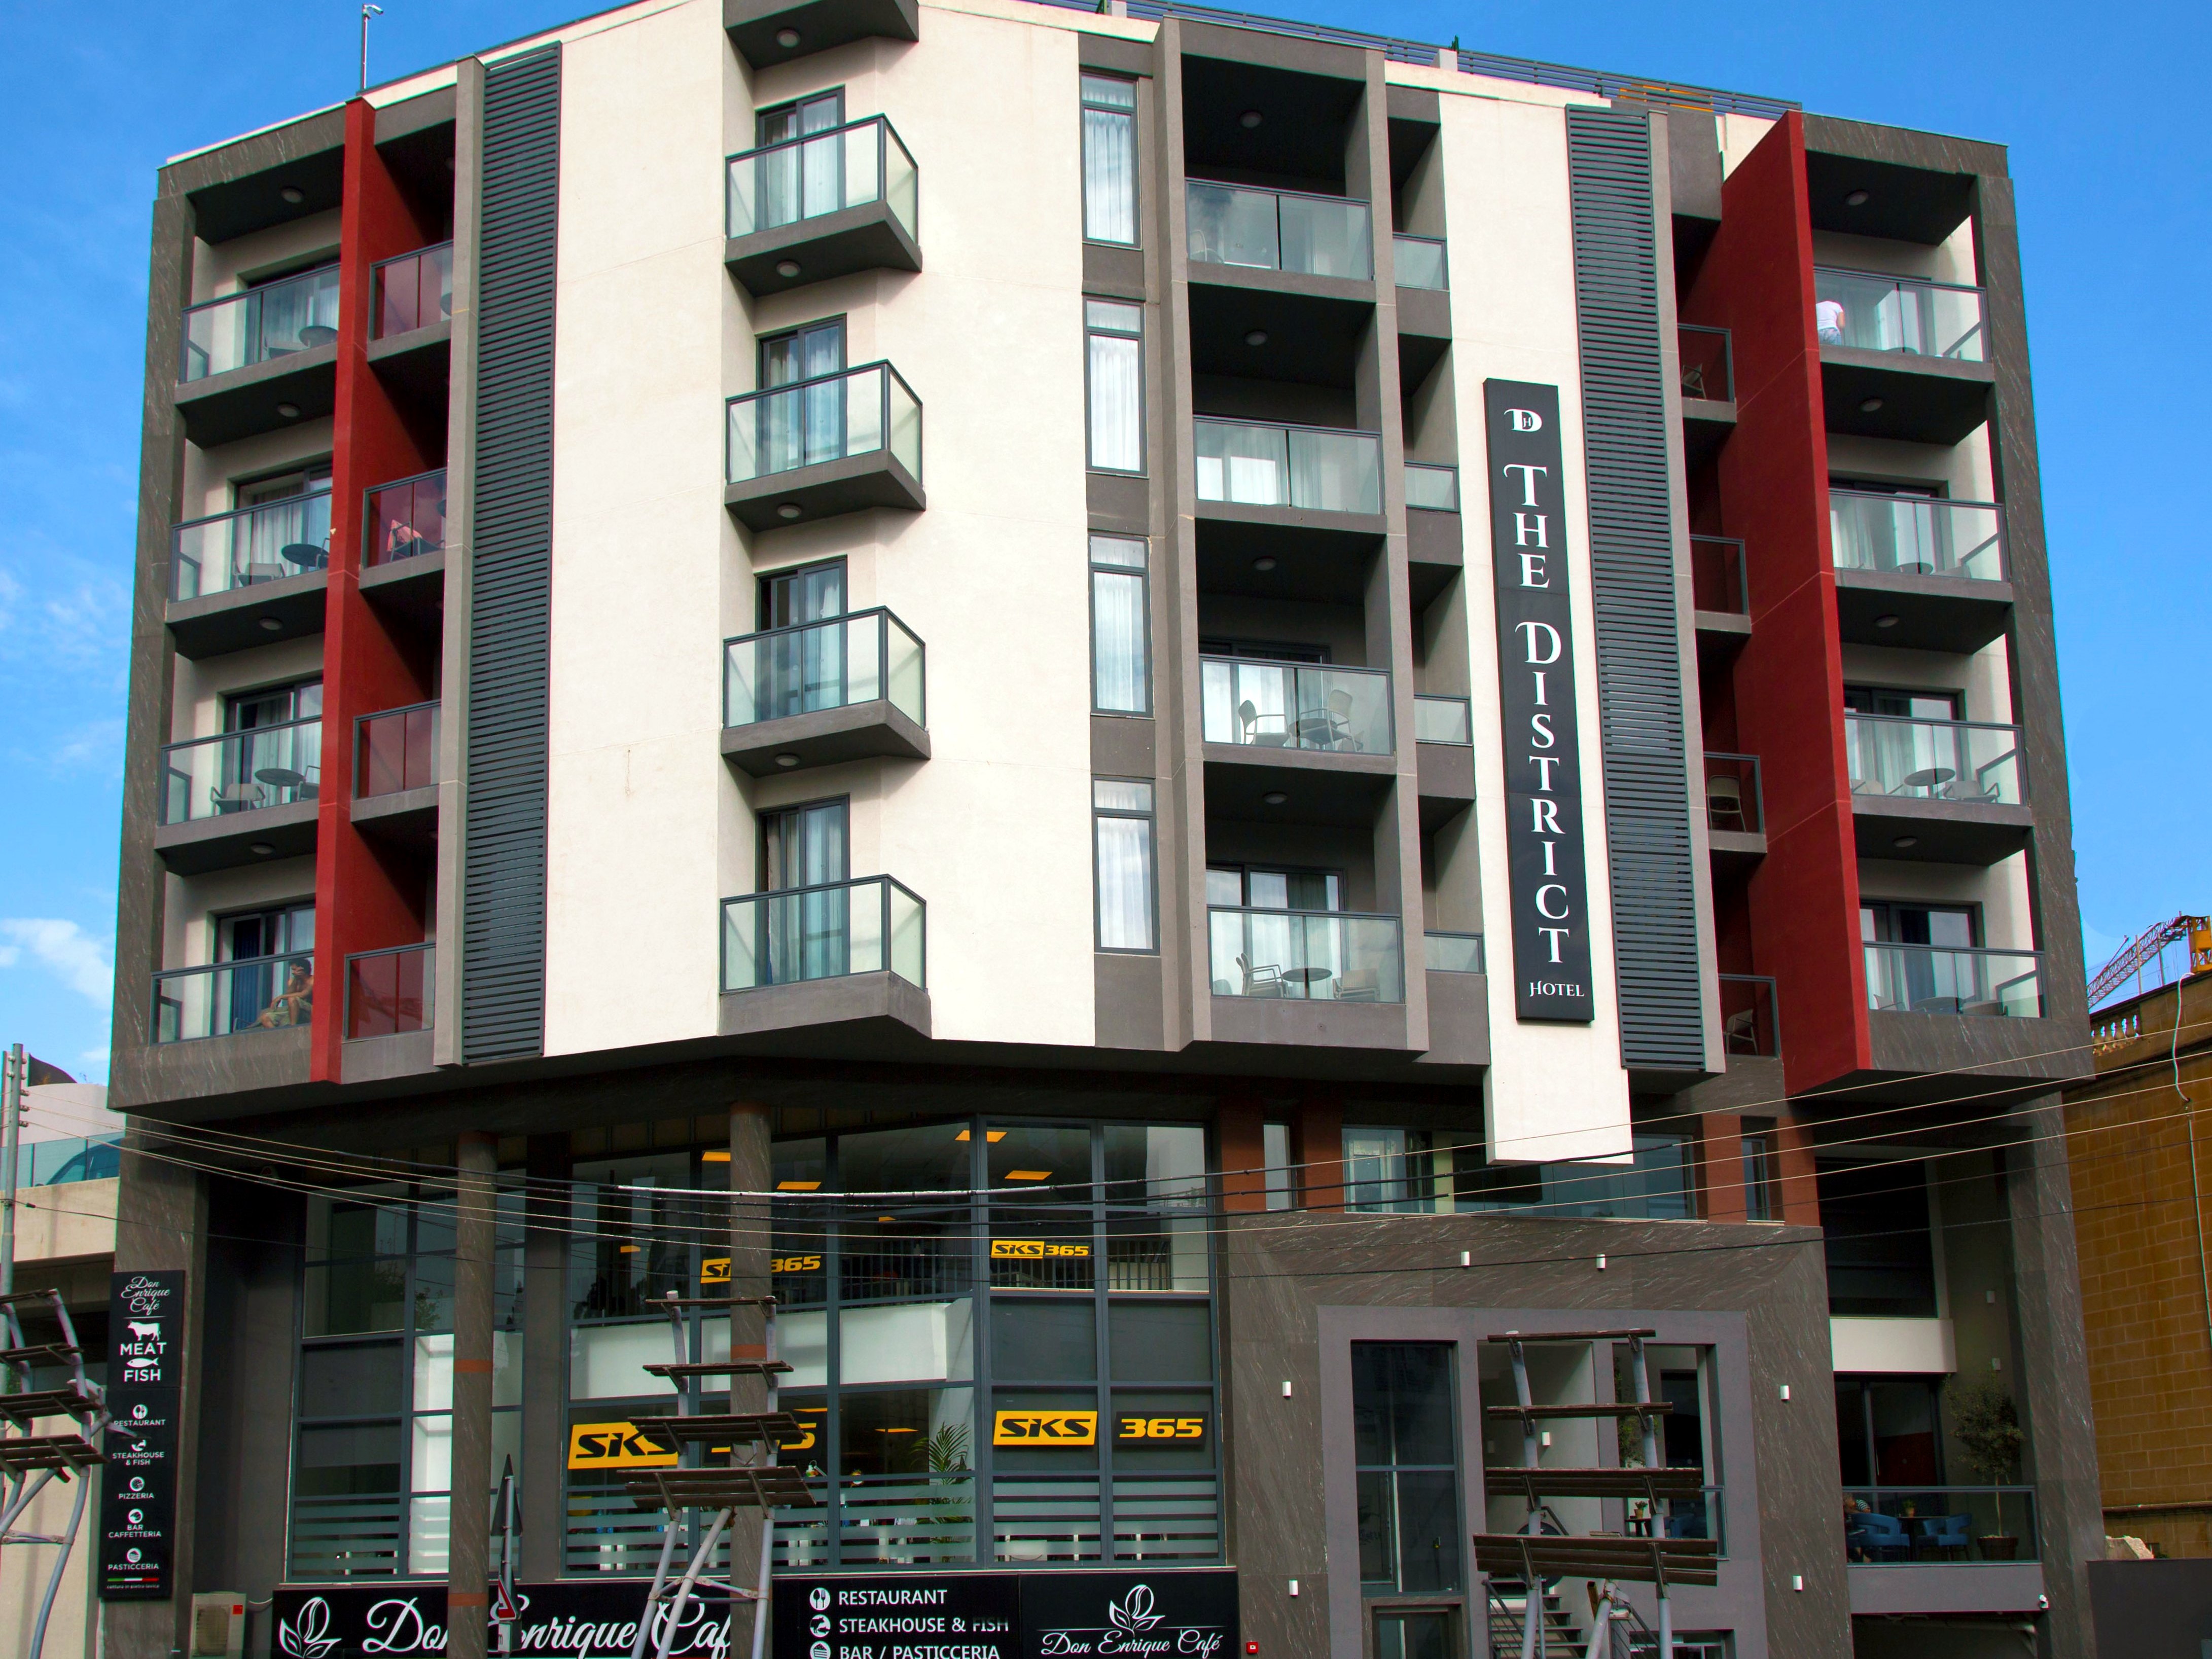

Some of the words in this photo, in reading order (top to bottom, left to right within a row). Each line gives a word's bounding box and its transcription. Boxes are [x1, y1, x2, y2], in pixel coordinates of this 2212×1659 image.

[1503, 463, 1550, 590] THE
[1515, 622, 1569, 964] DISTRICT
[1529, 980, 1585, 997] HOTEL
[994, 1244, 1043, 1255] SKS
[1045, 1245, 1089, 1256] 365
[131, 1276, 160, 1289] Don
[121, 1284, 170, 1301] Enrique
[129, 1297, 160, 1316] Café
[120, 1342, 167, 1356] MEAT
[124, 1368, 161, 1382] FISH
[1001, 1418, 1091, 1437] SKS
[1119, 1418, 1204, 1438] 365
[838, 1589, 948, 1605] RESTAURANT
[651, 1593, 731, 1659] Caf
[839, 1618, 946, 1633] STEAKHOUSE
[951, 1617, 966, 1633] &
[972, 1616, 1009, 1632] FISH
[840, 1646, 872, 1659] BAR
[879, 1646, 886, 1659] /
[893, 1645, 1001, 1659] PASTICCERIA
[1041, 1631, 1091, 1655] Don
[1098, 1630, 1171, 1659] Enrique
[1178, 1629, 1224, 1659] Café
